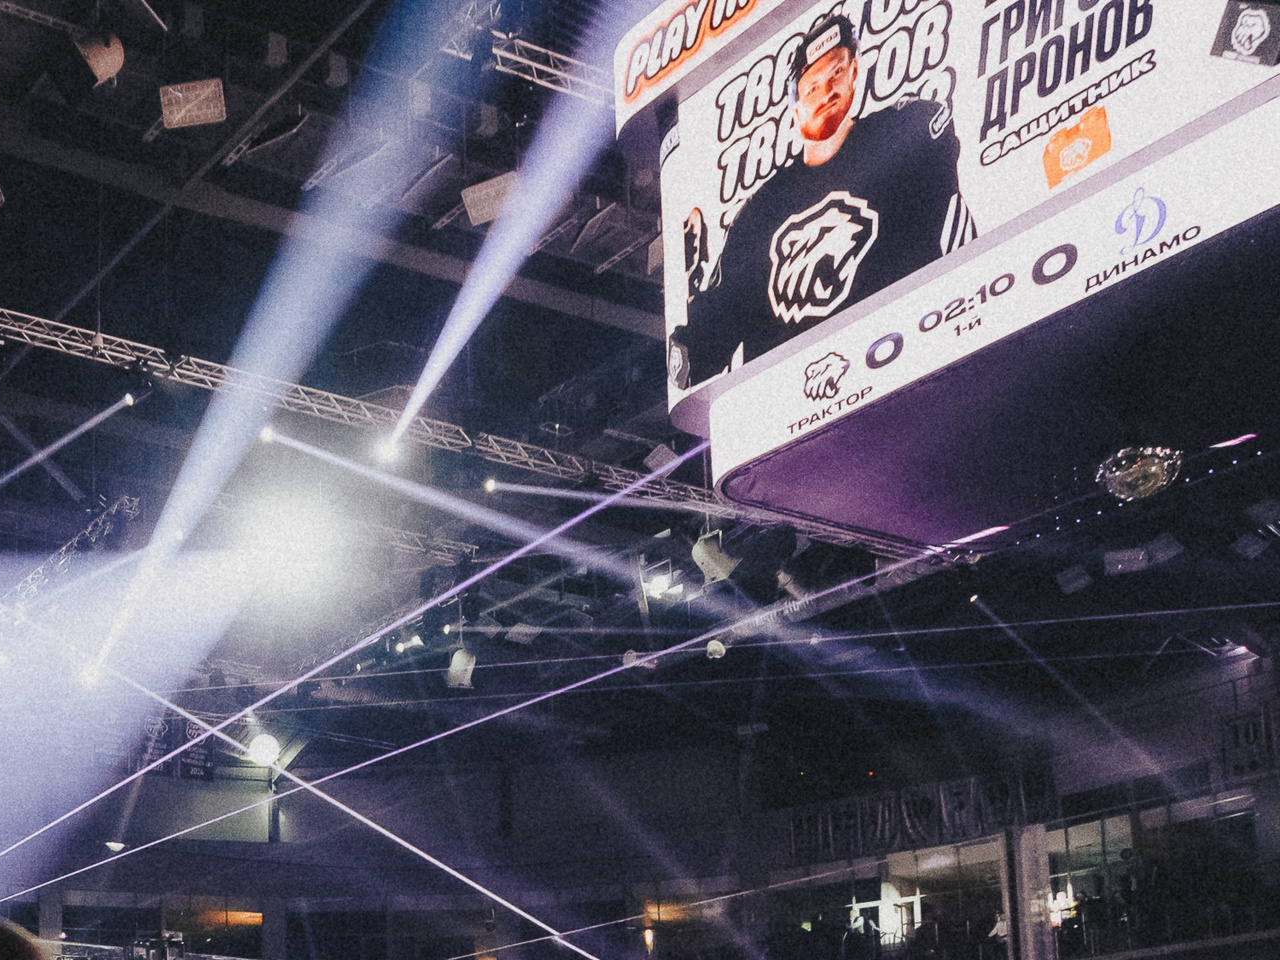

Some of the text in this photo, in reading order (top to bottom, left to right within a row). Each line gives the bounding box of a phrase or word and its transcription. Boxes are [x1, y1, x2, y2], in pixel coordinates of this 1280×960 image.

[625, 0, 708, 97] PLAY
[979, 0, 1154, 143] ДРОНОВ
[980, 48, 1157, 167] ЗАЩИТНИК
[865, 243, 1079, 369] 0 02:10 0
[1084, 225, 1201, 293] ДИНАМО
[787, 385, 874, 434] ТРАКТОР
